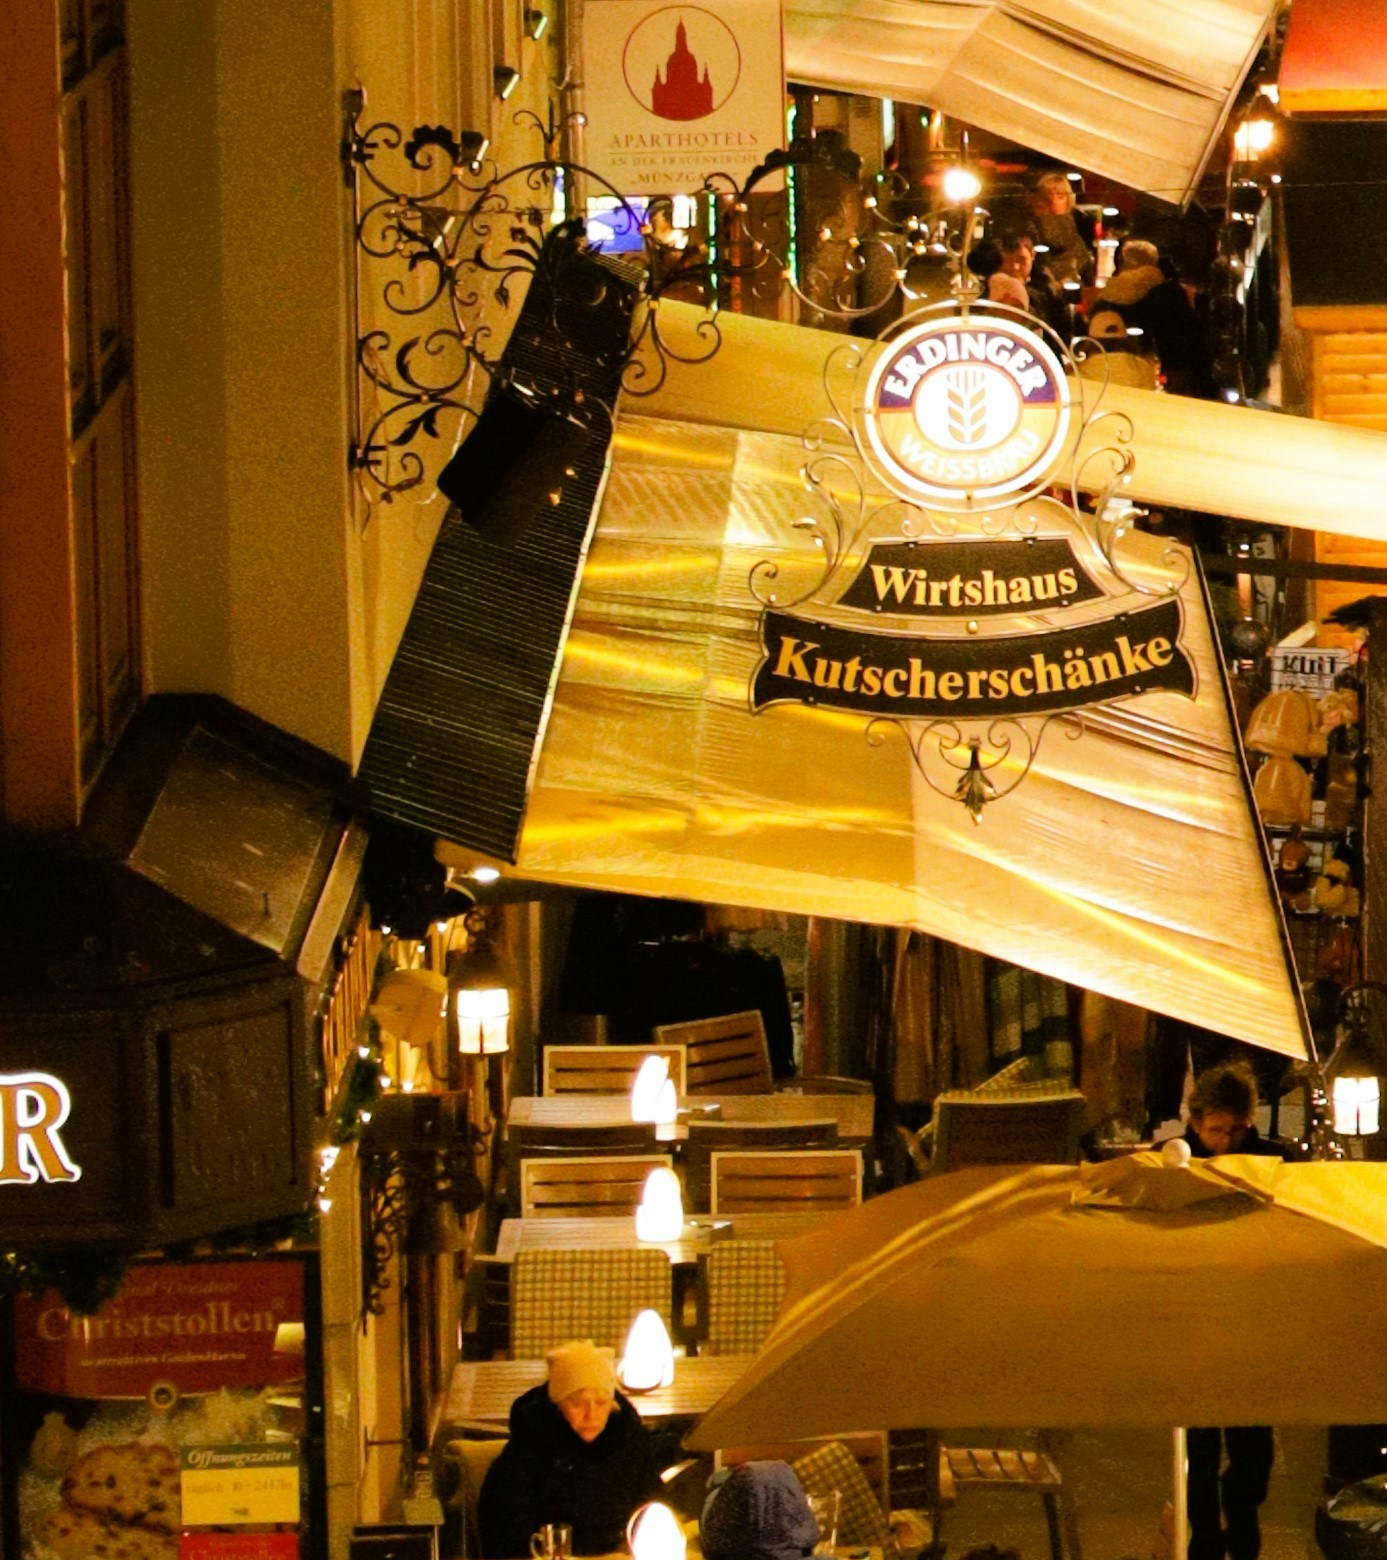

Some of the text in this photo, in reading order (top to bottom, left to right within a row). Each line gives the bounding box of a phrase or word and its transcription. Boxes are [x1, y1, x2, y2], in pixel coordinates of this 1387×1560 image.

[610, 131, 758, 148] APARTHOTELS
[610, 157, 627, 167] AN
[632, 156, 657, 166] DER
[884, 333, 1050, 398] ERDINGER
[870, 564, 1078, 607] Wirtshaus
[777, 634, 1175, 699] Kutscherschänke
[37, 1298, 276, 1342] Christstollen
